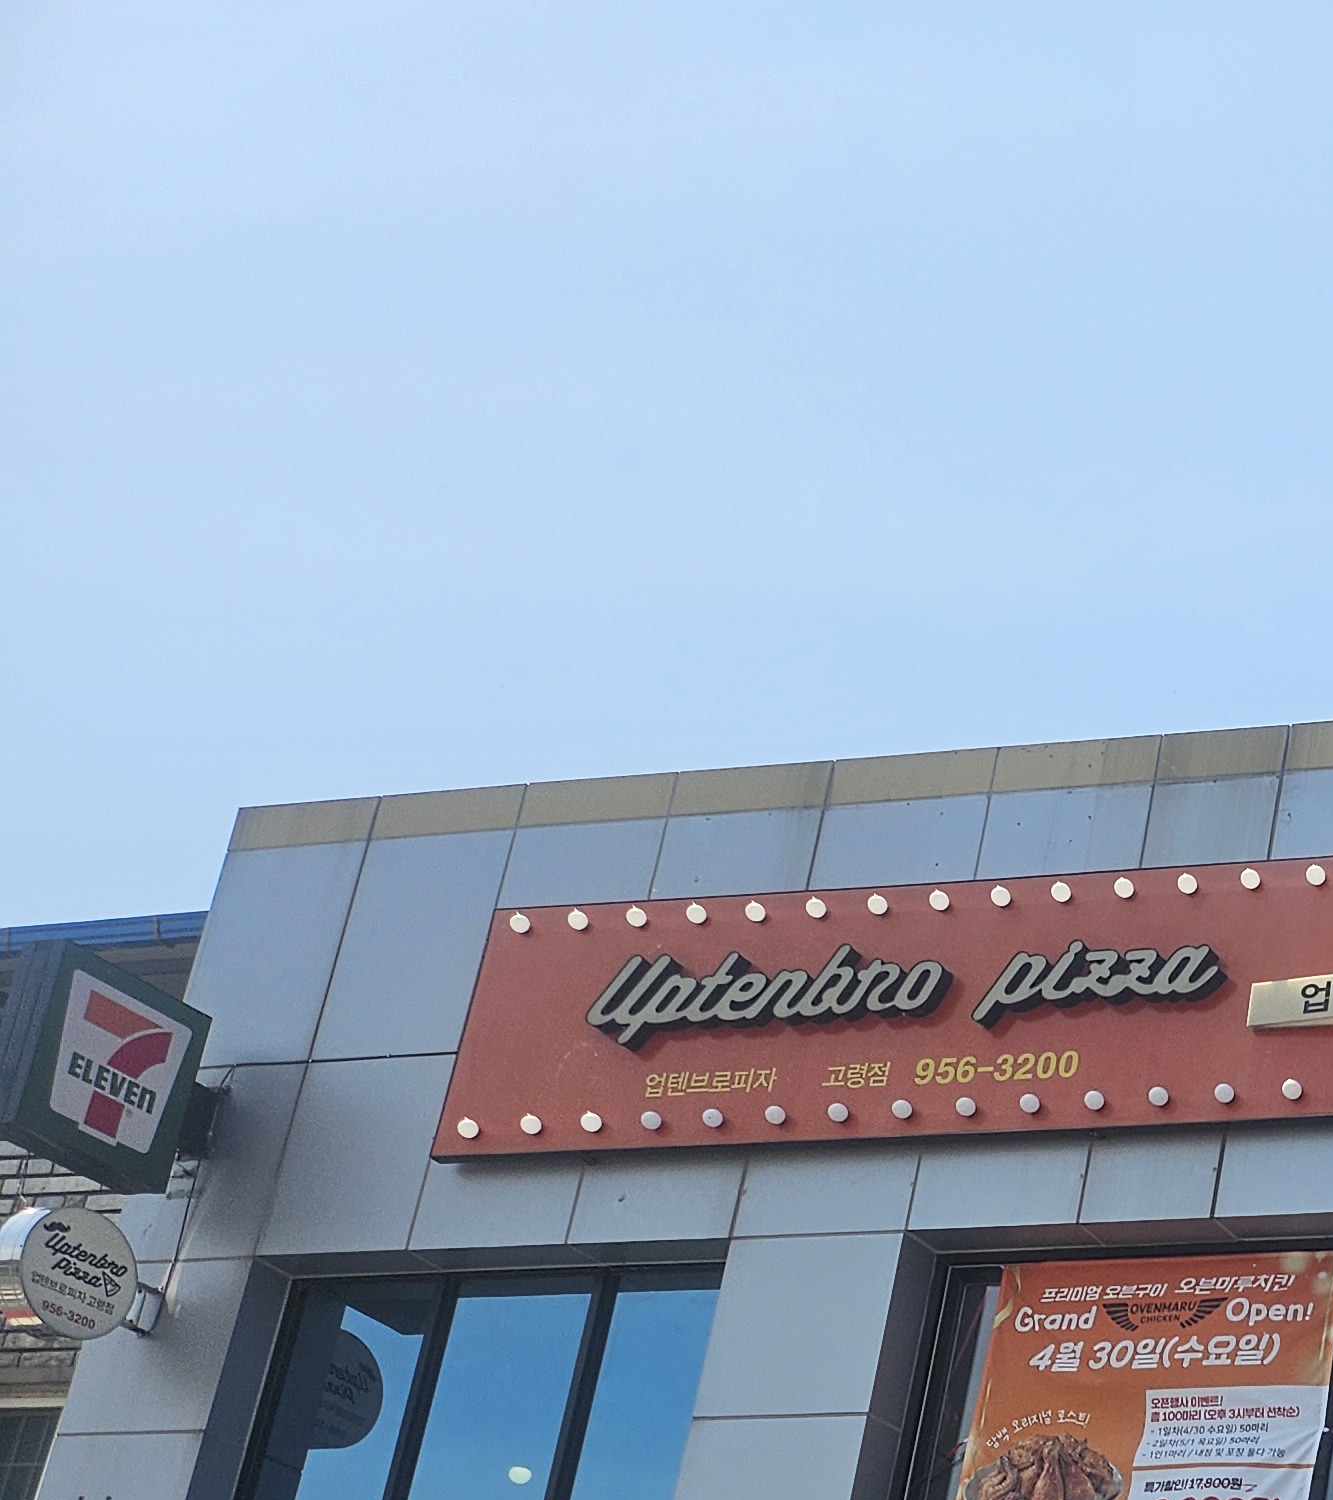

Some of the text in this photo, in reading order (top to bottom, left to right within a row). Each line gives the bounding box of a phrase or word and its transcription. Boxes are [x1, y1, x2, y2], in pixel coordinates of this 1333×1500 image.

[586, 940, 1226, 1050] Uptenbro pizza
[645, 1050, 1080, 1097] 업텐브로피자 고령점 956-3200
[45, 1232, 128, 1278] Uptenbro
[31, 1270, 115, 1316] 업텐브로피자 고령점
[1041, 1274, 1296, 1303] 프리미엄 오븐구이 오븐마루치킨
[42, 1300, 96, 1330] 956-3200
[1014, 1297, 1314, 1333] Grand Open!
[1129, 1301, 1197, 1316] OVENMARU
[1140, 1313, 1181, 1324] CHICKEN
[1029, 1332, 1281, 1372] 4월 30일(수요일)
[1151, 1395, 1223, 1409] 오픈행사 이벤트!
[1162, 1409, 1201, 1422] 100마리
[1229, 1407, 1265, 1419] 3시부터
[1267, 1406, 1300, 1418] 선착순)
[1011, 1409, 1052, 1433] 오리지널
[1240, 1422, 1269, 1432] 50마리
